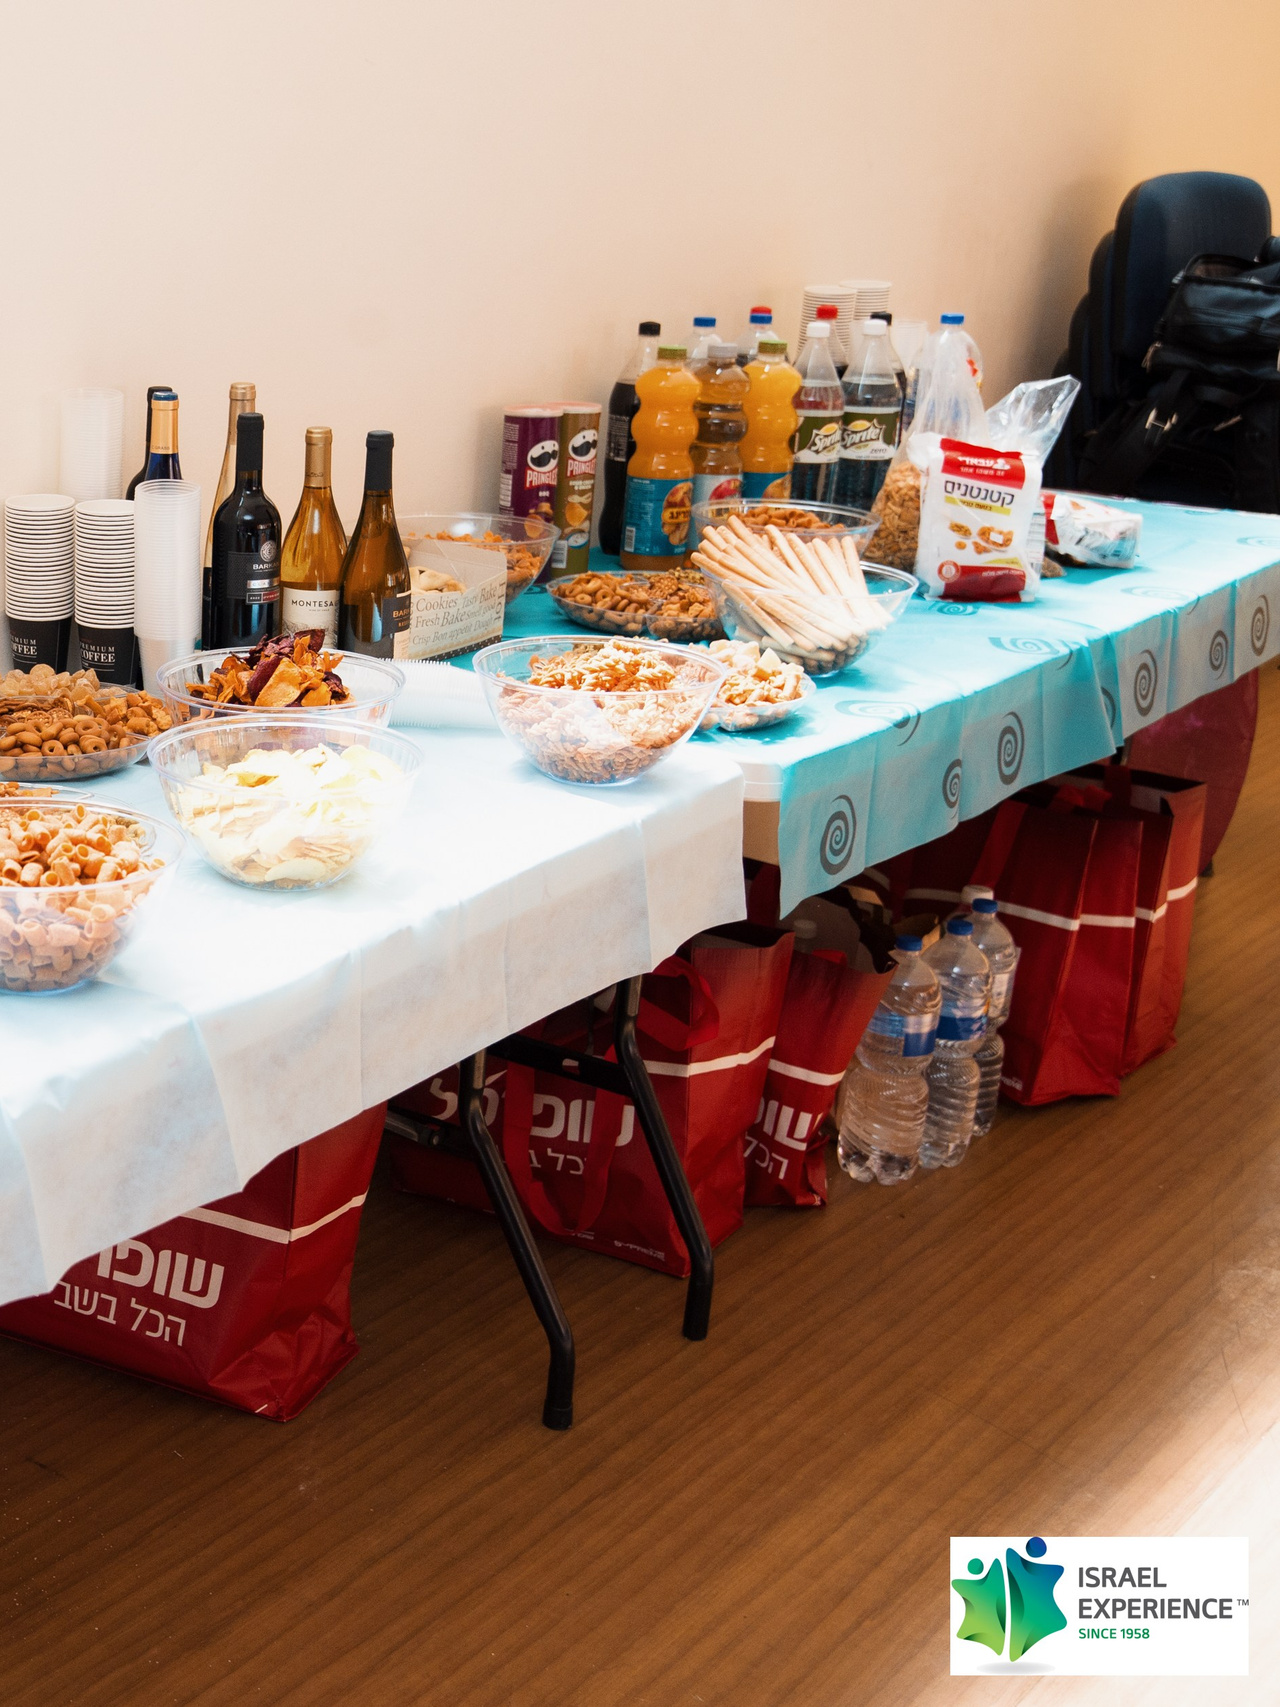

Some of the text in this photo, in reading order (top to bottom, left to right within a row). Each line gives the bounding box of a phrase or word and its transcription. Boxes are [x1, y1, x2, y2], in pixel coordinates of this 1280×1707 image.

[810, 430, 841, 451] Spri
[841, 425, 880, 447] Sprite
[526, 467, 558, 487] PRINGLES
[566, 459, 596, 476] PRINGLES
[944, 480, 1015, 507] קטנטנים
[416, 598, 458, 613] Cookies
[479, 585, 497, 604] Bake
[392, 608, 410, 618] BAR
[415, 613, 440, 629] Fresh
[441, 608, 467, 627] Bake
[11, 635, 37, 646] EMIUM
[412, 633, 431, 647] Crisp
[433, 624, 448, 643] Bon
[81, 642, 115, 653] REMIUM
[743, 1131, 788, 1180] הכל
[97, 1239, 225, 1309] שופ
[54, 1281, 186, 1346] הכל בשב
